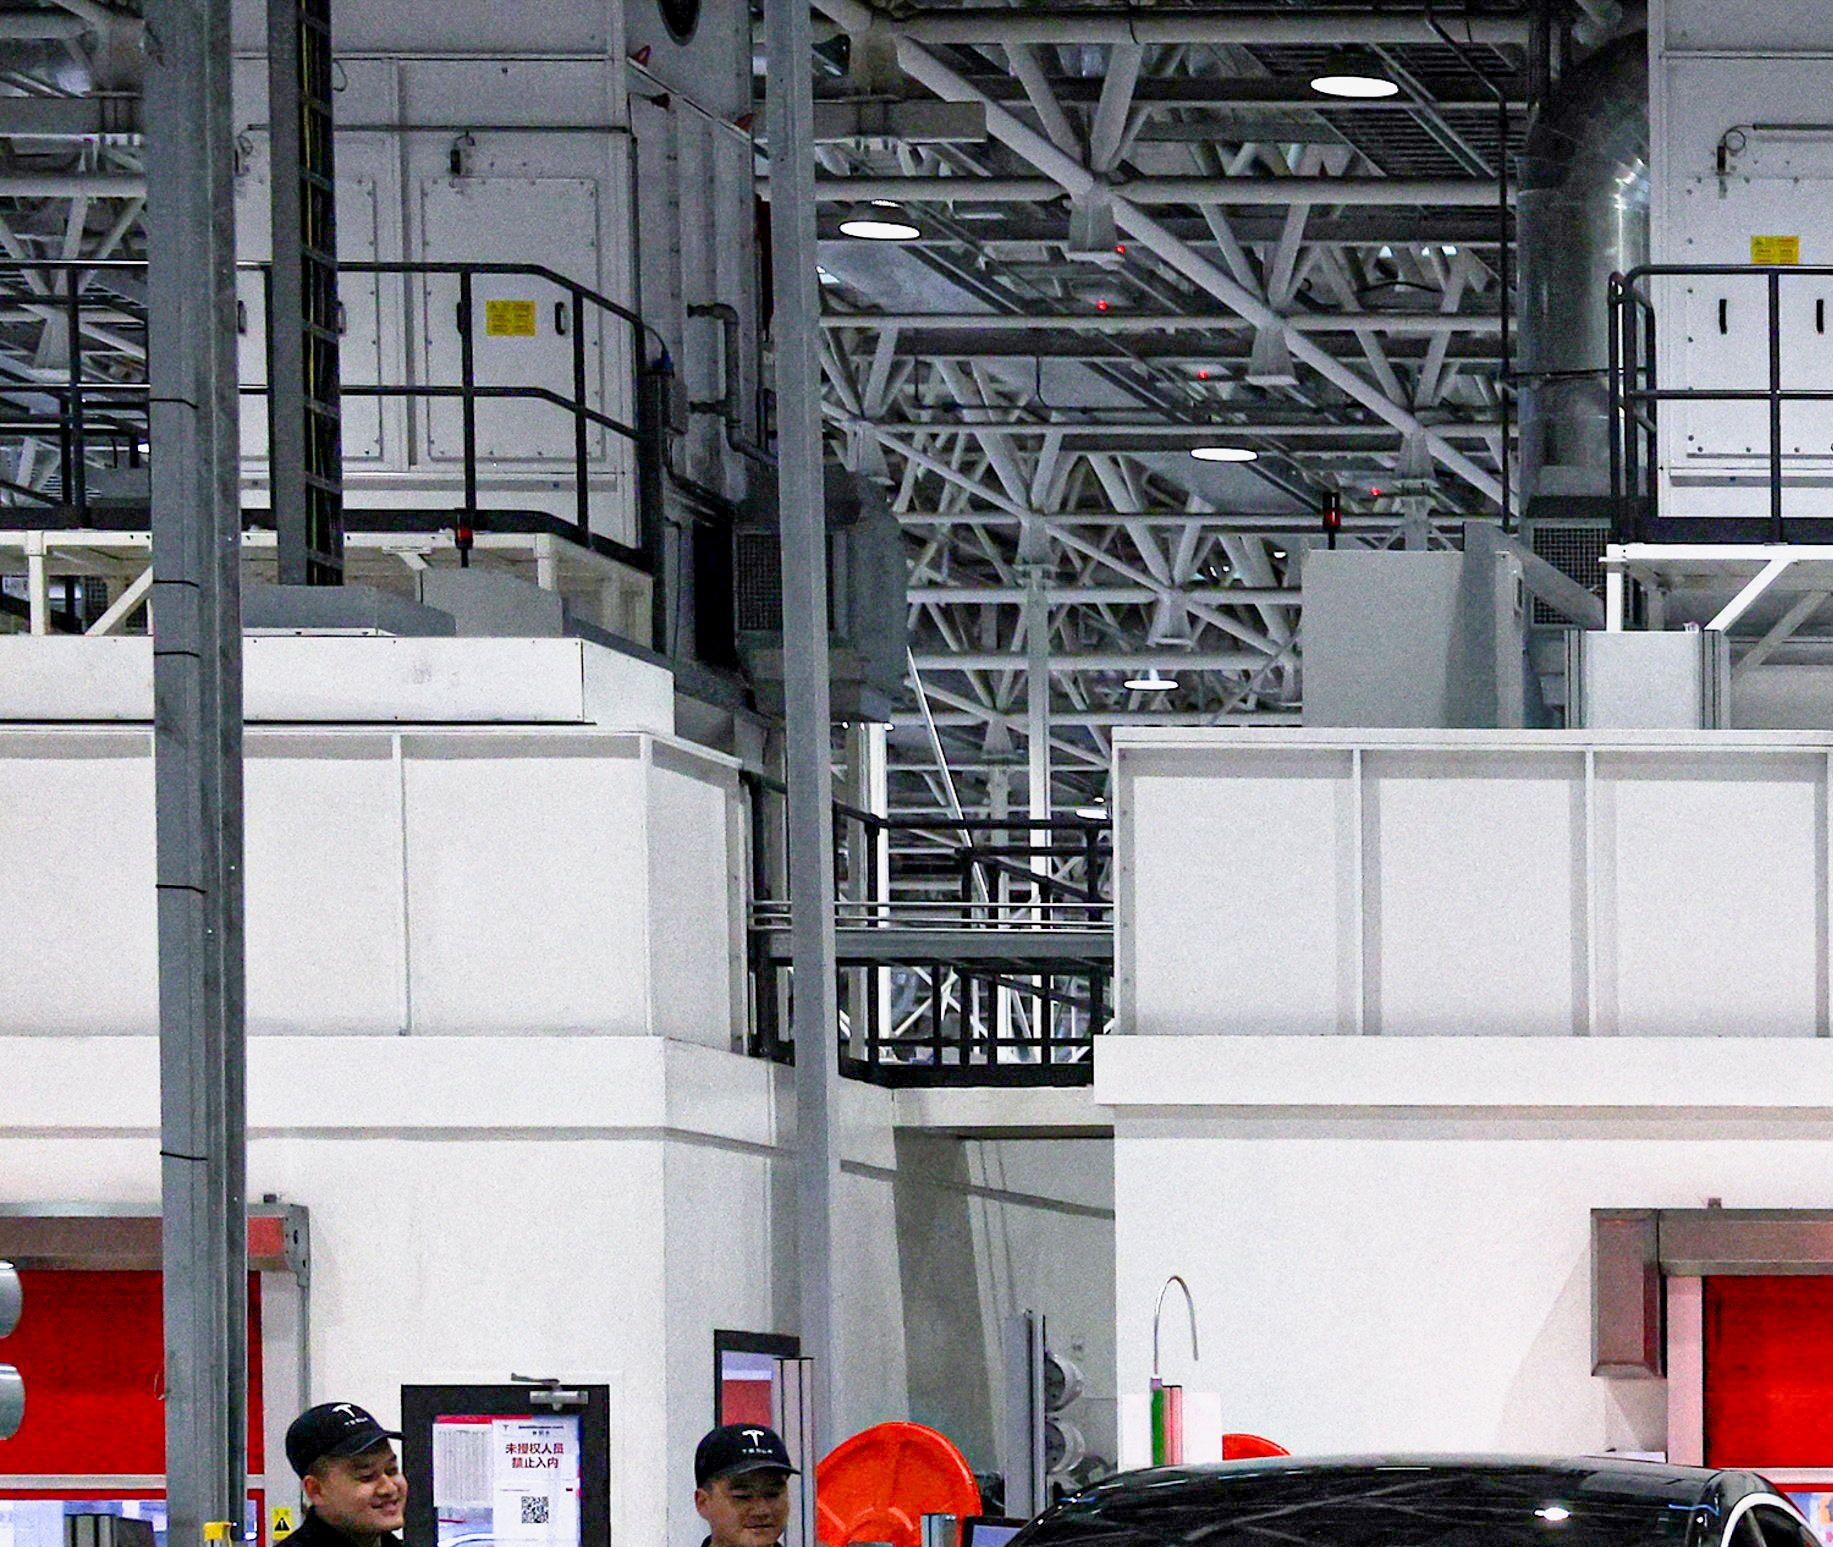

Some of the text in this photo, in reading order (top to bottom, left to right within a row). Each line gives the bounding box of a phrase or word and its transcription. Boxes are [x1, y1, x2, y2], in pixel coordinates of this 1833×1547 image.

[505, 1442, 564, 1454] 未授权人员
[511, 1457, 559, 1468] 禁止入内
